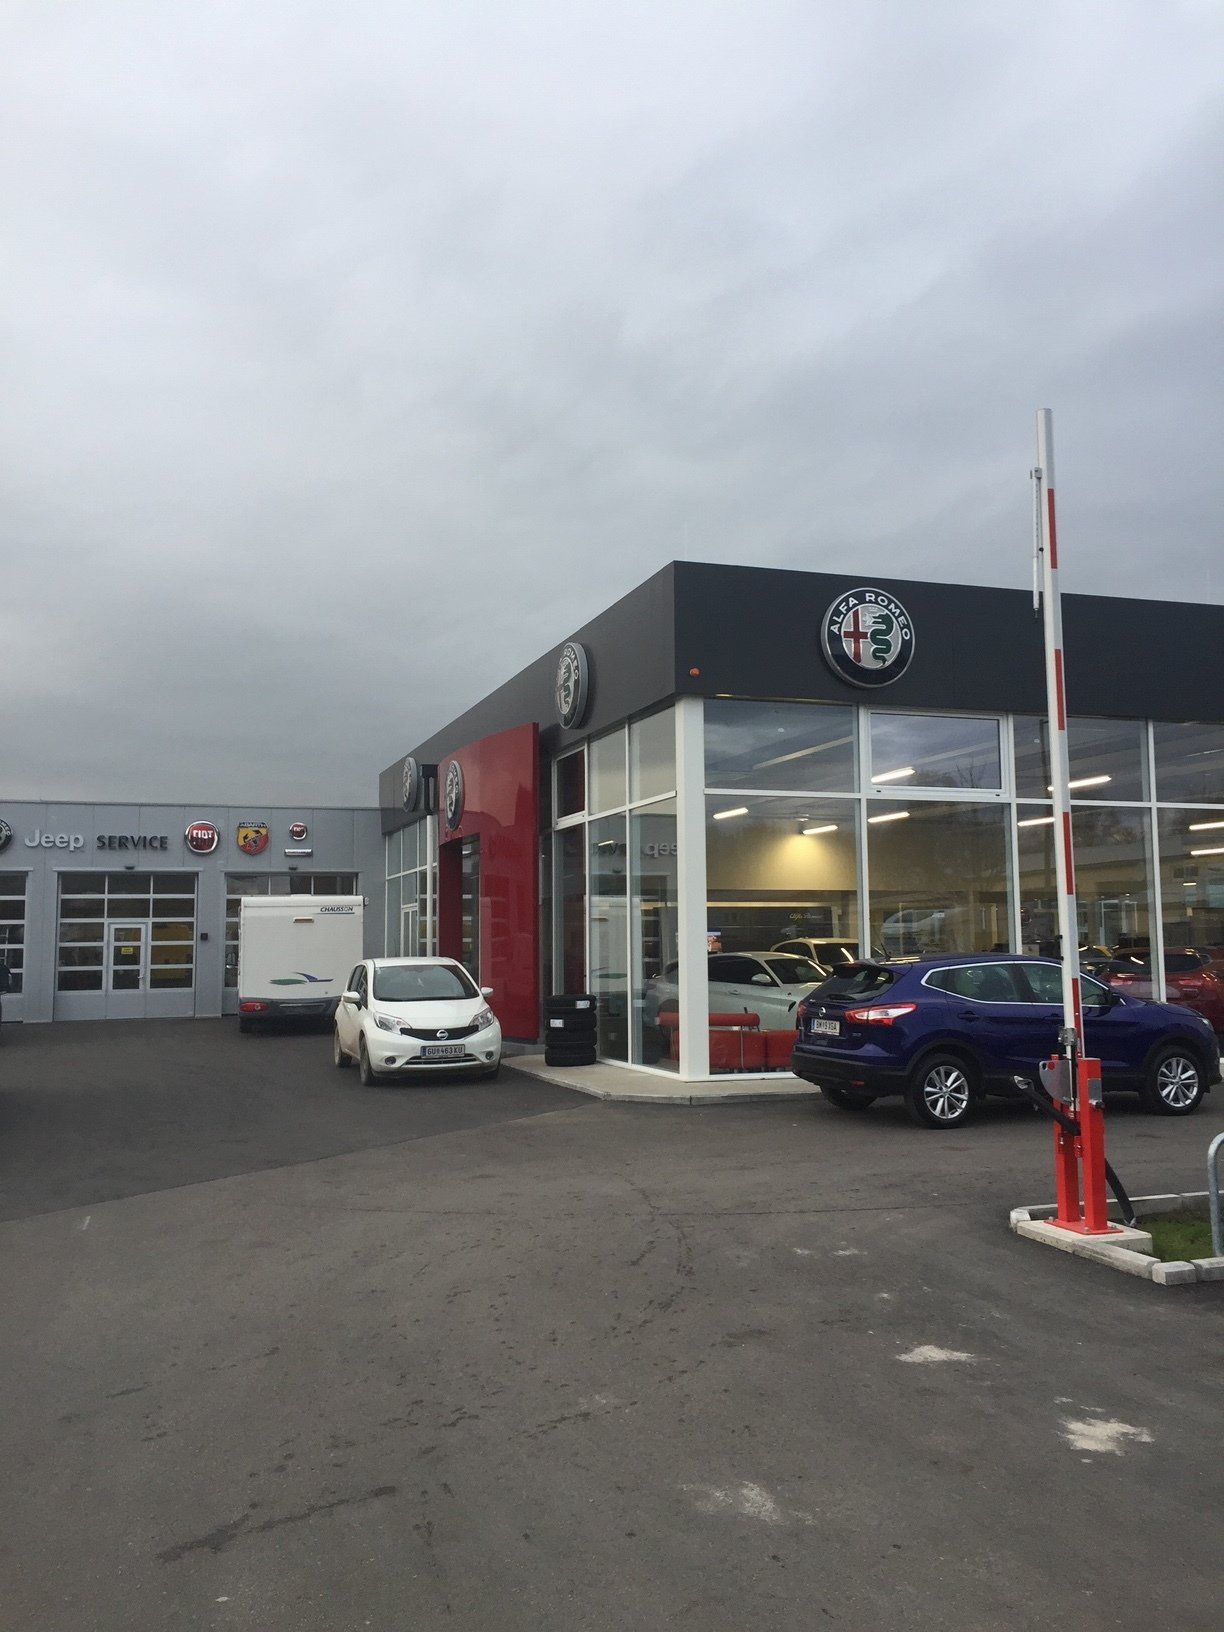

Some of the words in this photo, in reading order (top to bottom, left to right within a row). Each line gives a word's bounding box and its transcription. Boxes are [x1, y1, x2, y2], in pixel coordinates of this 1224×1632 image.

[830, 597, 859, 635] ALFA
[865, 593, 911, 640] ROMEO
[24, 828, 84, 851] Jeep
[96, 835, 168, 850] SERVICE
[192, 829, 214, 839] FIAT
